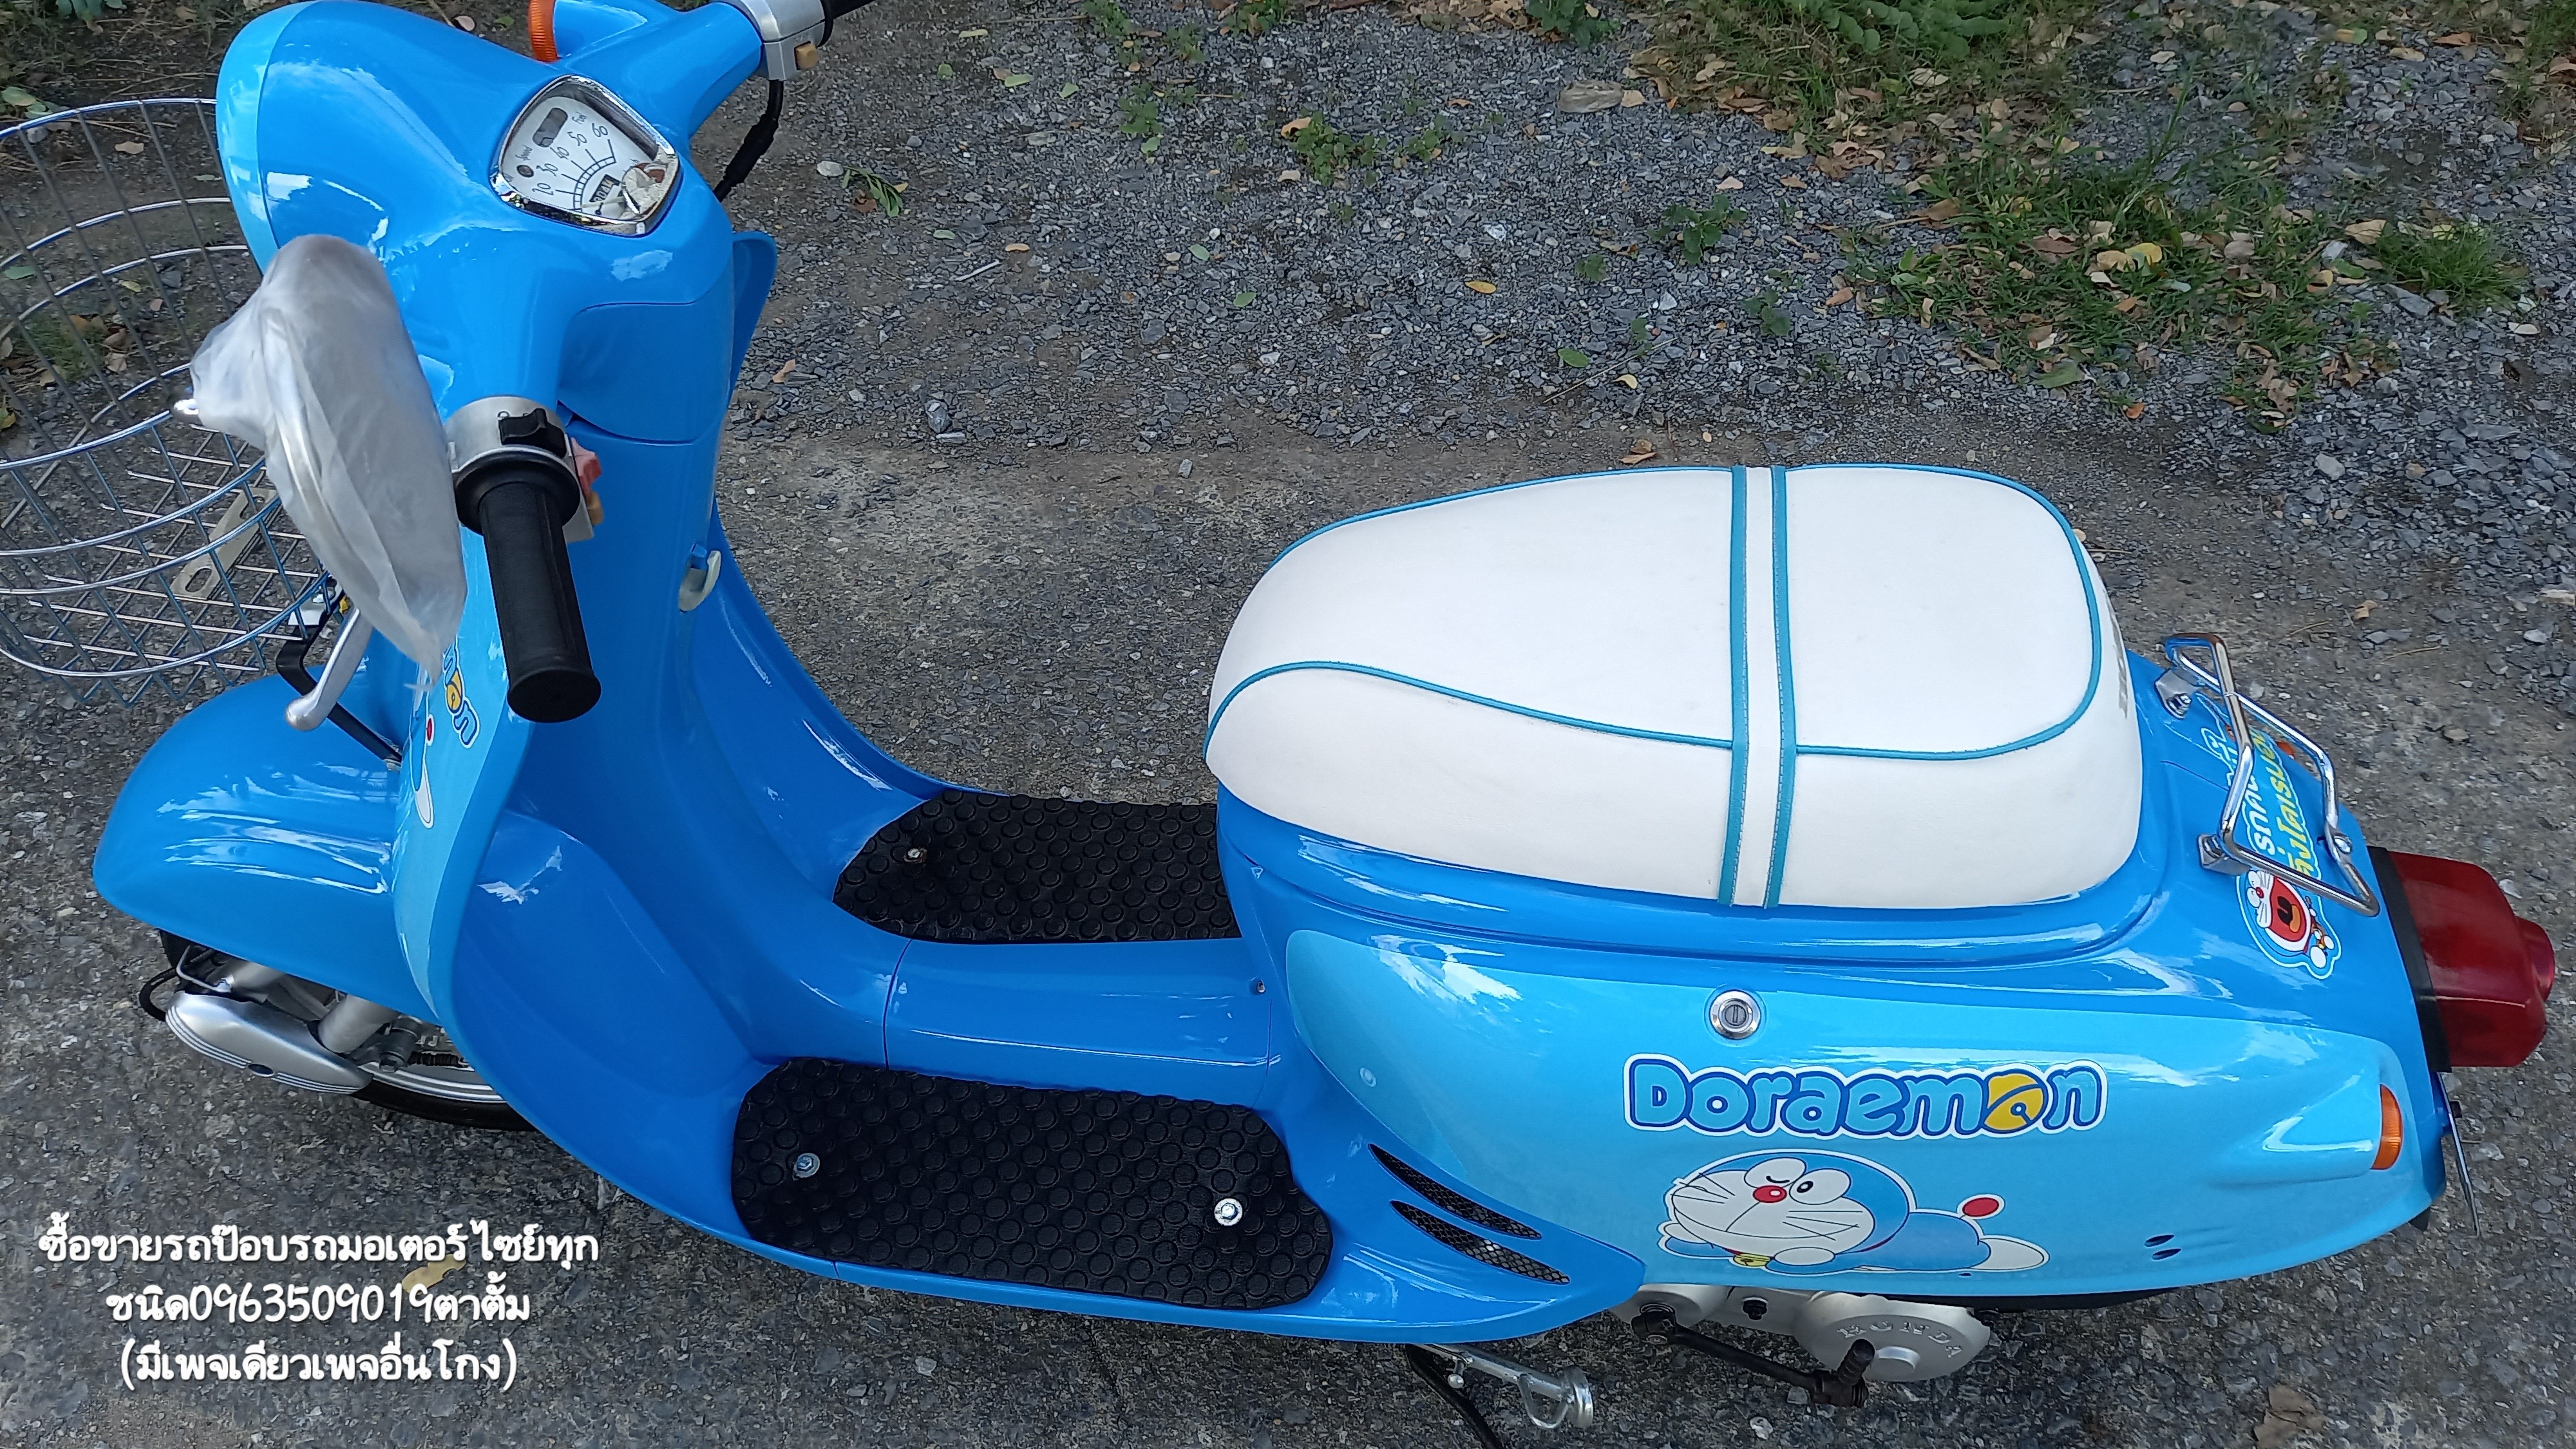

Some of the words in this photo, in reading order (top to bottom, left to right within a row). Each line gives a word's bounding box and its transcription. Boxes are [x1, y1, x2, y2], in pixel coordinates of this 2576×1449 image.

[592, 122, 609, 137] 60
[567, 131, 587, 146] 50
[549, 146, 570, 160] 40
[536, 163, 558, 176] 30
[531, 182, 554, 196] 20
[1627, 1057, 2103, 1136] Doraemon
